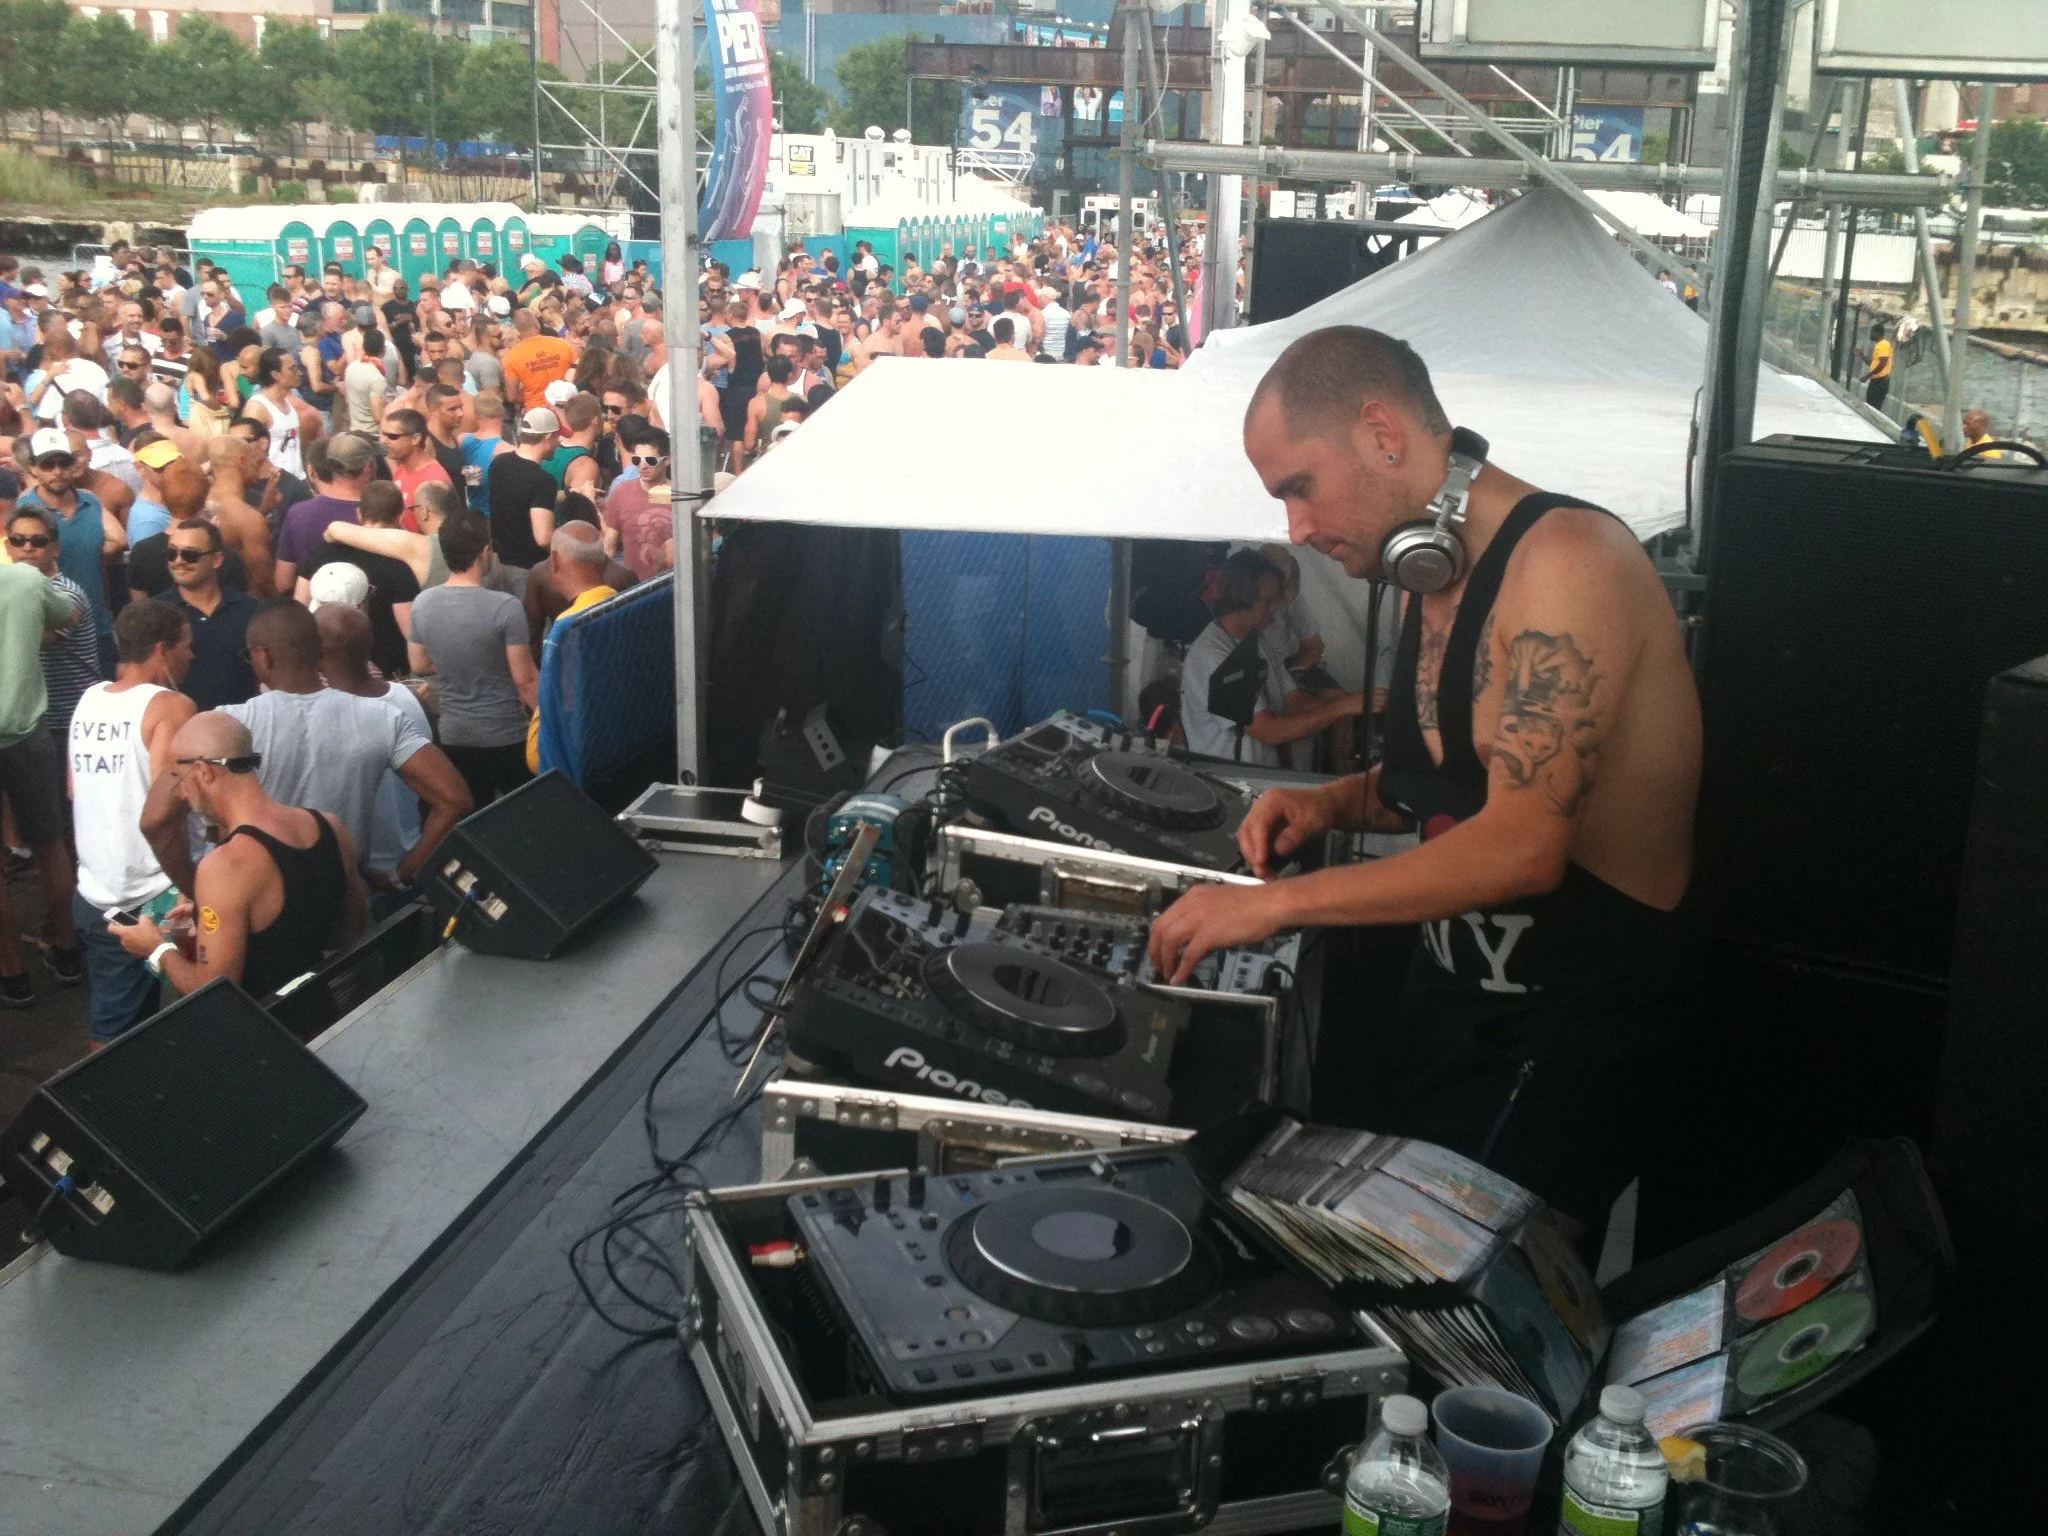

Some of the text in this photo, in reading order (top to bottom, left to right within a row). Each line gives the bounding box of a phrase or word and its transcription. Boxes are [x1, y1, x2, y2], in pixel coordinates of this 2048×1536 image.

[714, 11, 765, 64] PIER
[971, 94, 1006, 107] er
[968, 108, 1038, 152] 54
[73, 721, 131, 741] EVENT
[75, 753, 125, 774] STAFF
